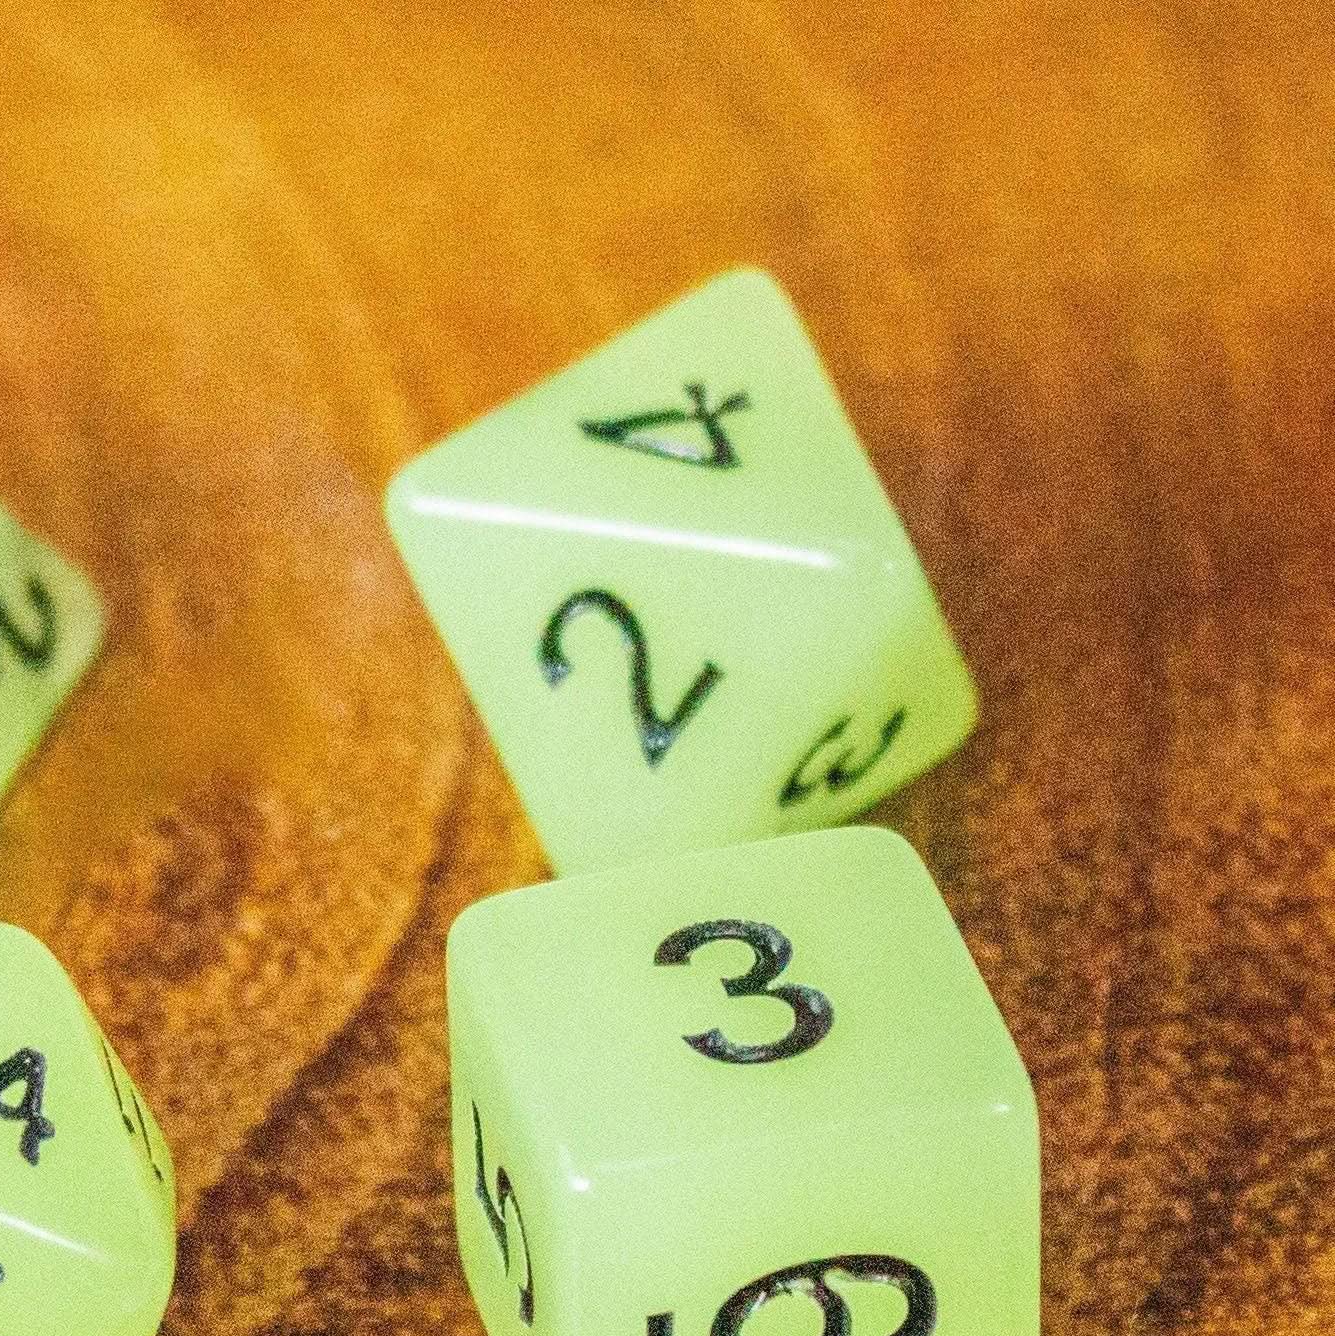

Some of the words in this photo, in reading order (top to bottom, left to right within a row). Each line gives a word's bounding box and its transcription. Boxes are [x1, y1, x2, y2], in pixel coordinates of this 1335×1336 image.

[578, 382, 752, 469] 4
[537, 588, 726, 769] 2
[653, 918, 834, 1065] 3
[470, 1100, 535, 1327] 5
